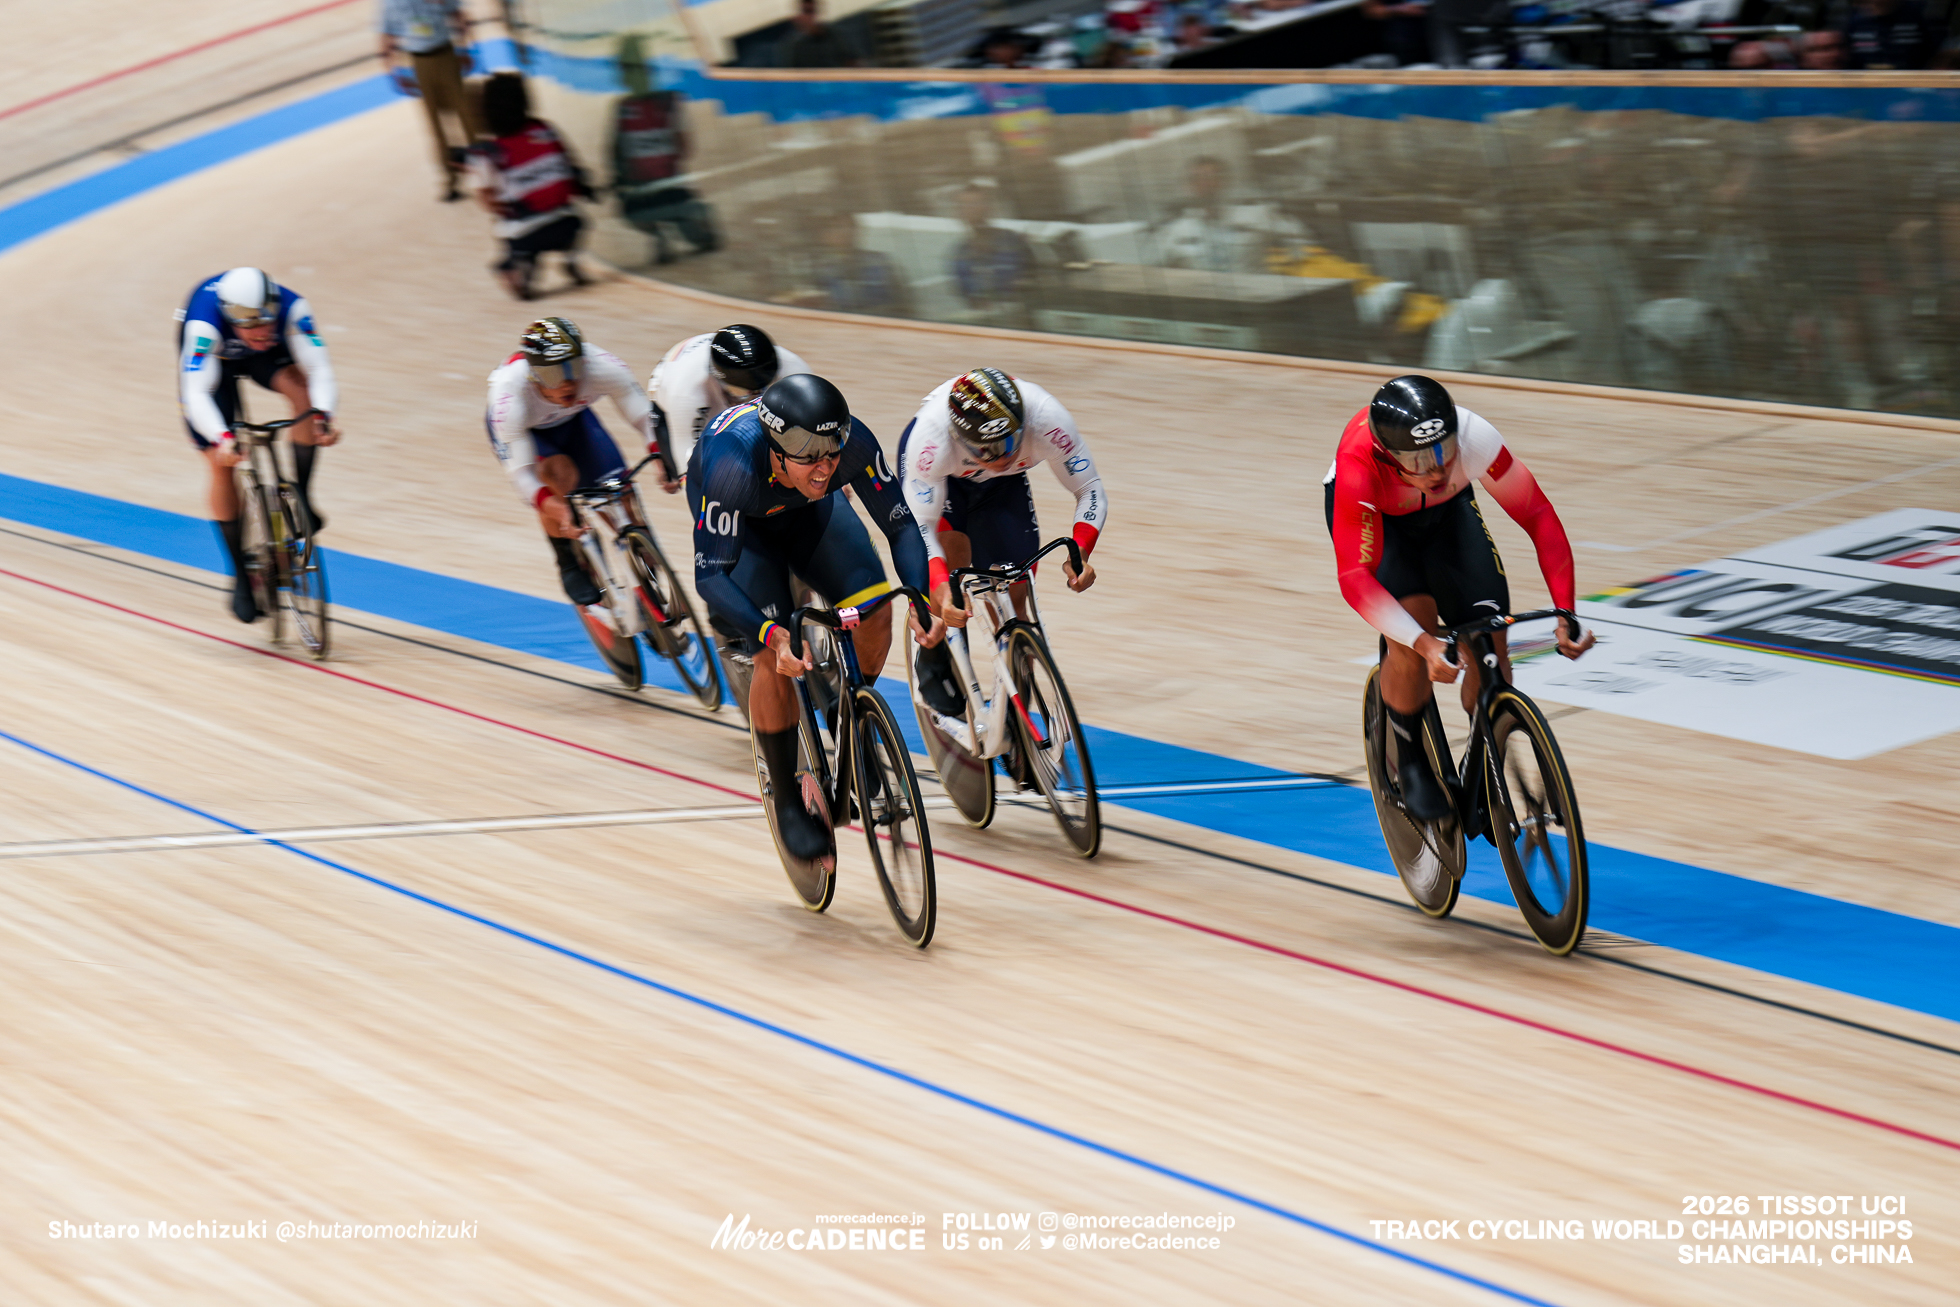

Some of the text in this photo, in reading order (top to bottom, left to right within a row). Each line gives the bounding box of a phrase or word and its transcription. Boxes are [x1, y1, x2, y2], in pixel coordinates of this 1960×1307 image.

[816, 421, 839, 432] LAZER
[705, 500, 740, 537] Col
[1358, 511, 1375, 564] CHINA
